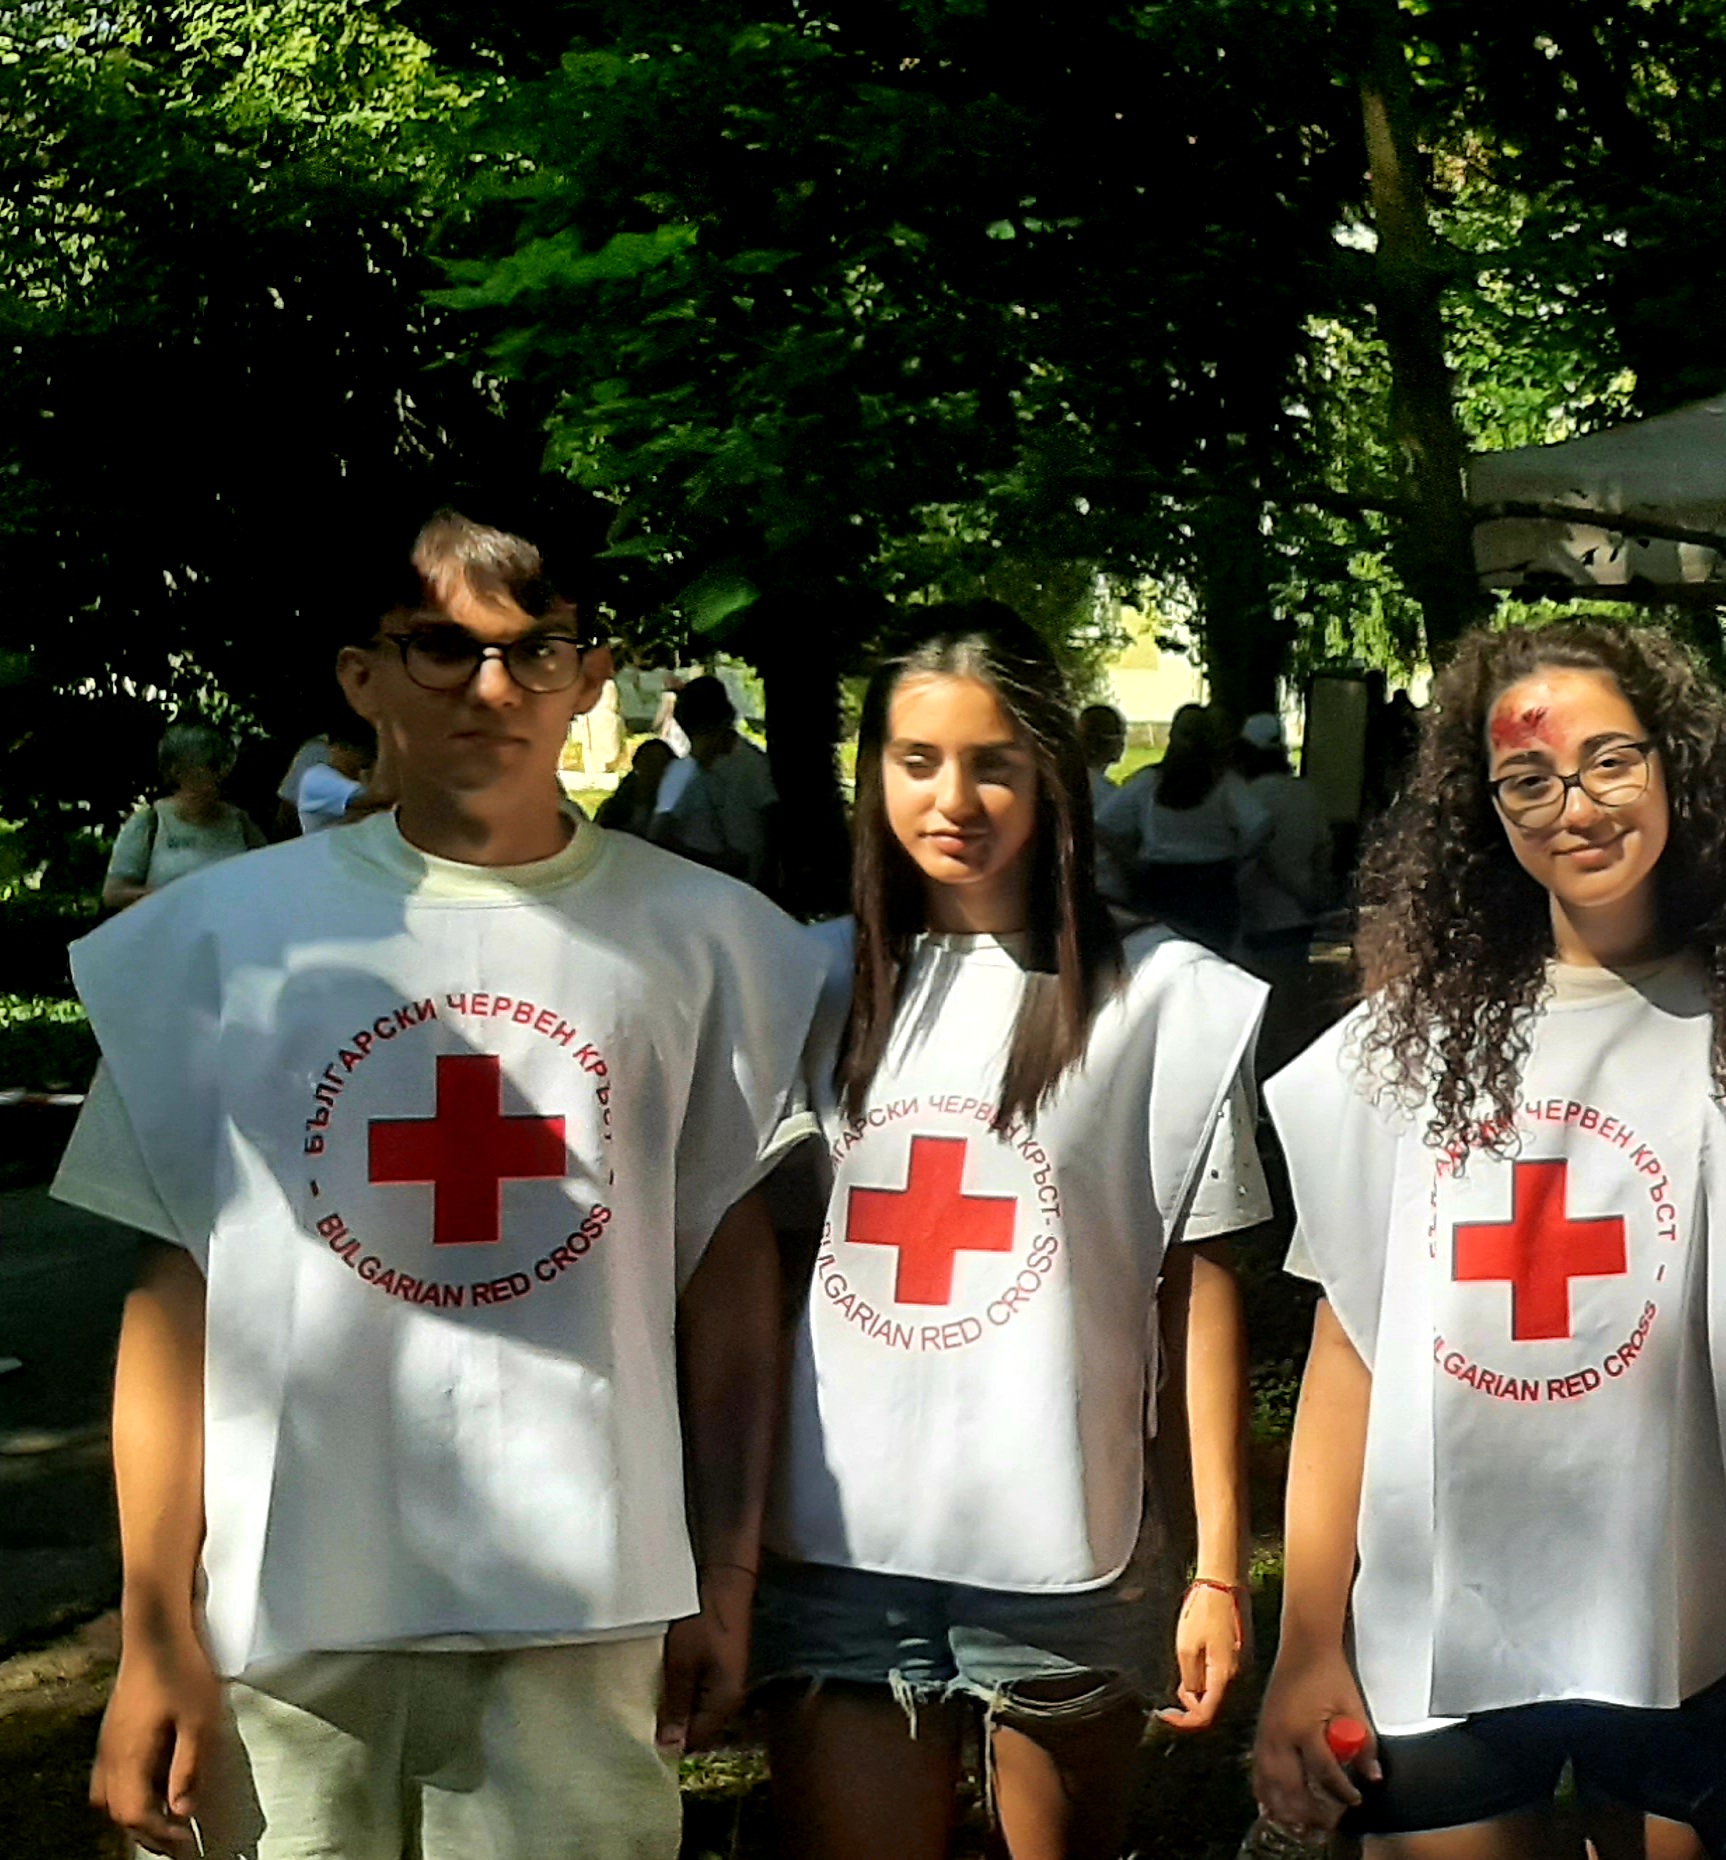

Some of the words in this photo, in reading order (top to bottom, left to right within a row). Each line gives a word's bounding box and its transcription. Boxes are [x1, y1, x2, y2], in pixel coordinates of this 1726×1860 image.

[304, 998, 438, 1157] БЪЛГАРСКИ
[446, 993, 577, 1047] ЧЕРВЕН
[832, 1096, 919, 1167] ГАРСКИ
[928, 1095, 1023, 1144] ЧЕРВН
[1017, 1138, 1060, 1219] КРЪСТ
[1525, 1099, 1634, 1150] ЧЕРВЕН
[1629, 1143, 1677, 1241] КРЪСТ
[316, 1213, 465, 1308] BULGARIAN
[471, 1271, 531, 1307] RED
[534, 1203, 612, 1283] CROSS
[921, 1316, 983, 1351] RED
[987, 1234, 1058, 1326] CROSS
[1547, 1367, 1601, 1400] RED
[1603, 1300, 1657, 1378] CROSS
